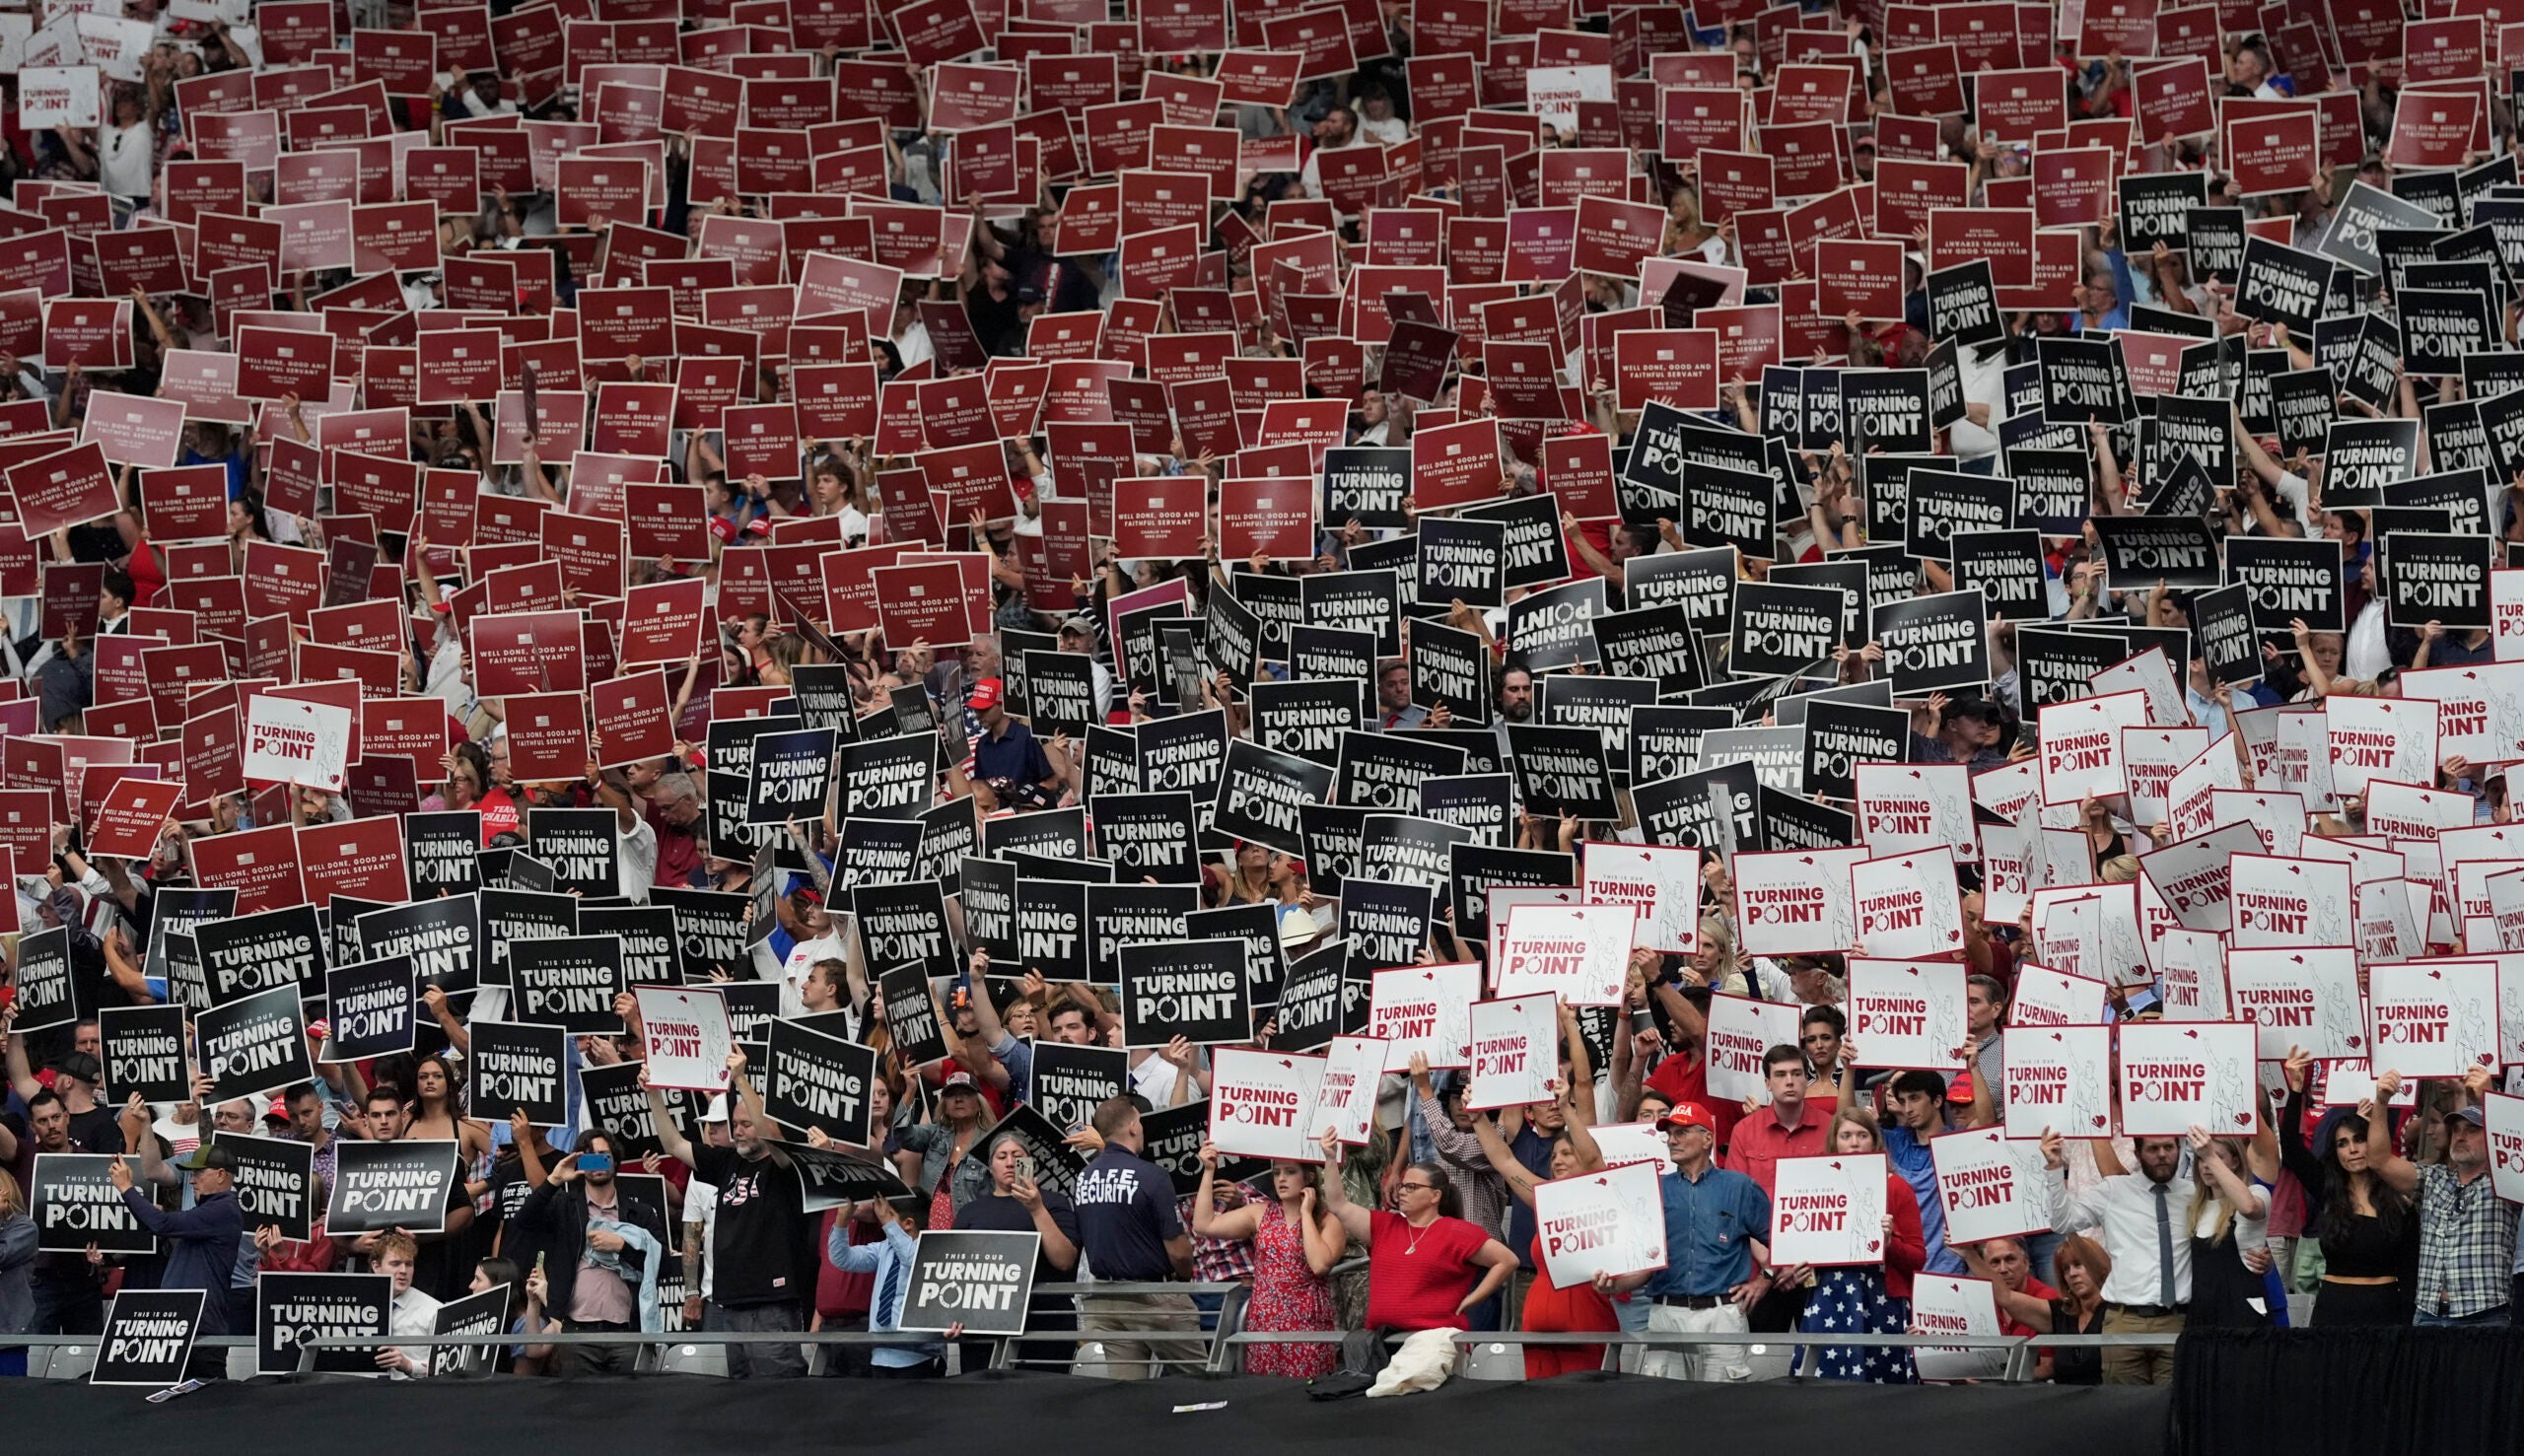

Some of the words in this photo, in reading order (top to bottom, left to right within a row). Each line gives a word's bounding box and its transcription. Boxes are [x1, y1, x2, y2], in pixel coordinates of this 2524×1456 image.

[1532, 90, 1581, 101] TURNING
[2248, 265, 2319, 296] TURNING
[2246, 282, 2320, 320] POINT
[2406, 315, 2478, 335] TURNING
[2048, 365, 2115, 386] TURNING
[2053, 382, 2117, 406] POINT
[2332, 447, 2406, 465] TURNING
[1330, 473, 1403, 490] TURNING
[2015, 473, 2083, 493] TURNING
[2329, 463, 2406, 490] POINT
[1331, 489, 1404, 511] POINT
[1690, 489, 1766, 517] TURNING
[2019, 493, 2084, 518] POINT
[1692, 509, 1766, 540] POINT
[1425, 543, 1495, 564] TURNING
[1426, 563, 1495, 589] POINT
[2234, 567, 2331, 586] TURNING
[2396, 562, 2481, 581] TURNING
[2248, 586, 2331, 611] POINT
[2399, 582, 2481, 607] POINT
[1743, 611, 1832, 633] TURNING
[1744, 630, 1834, 659] POINT
[1879, 620, 1975, 648] TURNING
[1885, 639, 1976, 673] POINT
[252, 725, 315, 743] TURNING
[2329, 731, 2395, 747] TURNING
[253, 738, 315, 760] POINT
[1145, 739, 1220, 766] TURNING
[2329, 746, 2395, 768] POINT
[759, 757, 826, 781] TURNING
[847, 761, 926, 788] TURNING
[1149, 757, 1223, 793] POINT
[758, 776, 824, 804] POINT
[848, 779, 925, 812] POINT
[1863, 800, 1930, 813] TURNING
[1102, 822, 1185, 841] TURNING
[1867, 815, 1931, 834] POINT
[412, 840, 475, 858] TURNING
[1106, 841, 1187, 869] POINT
[415, 859, 474, 883] POINT
[1743, 887, 1824, 903] TURNING
[2236, 893, 2307, 912] TURNING
[864, 912, 939, 934] TURNING
[1348, 911, 1421, 935] TURNING
[1747, 903, 1825, 925] POINT
[2240, 911, 2307, 935] POINT
[268, 931, 290, 939] OUR
[870, 932, 941, 960] POINT
[209, 936, 311, 968] TURNING
[17, 957, 64, 984] TURNING
[218, 954, 314, 994] POINT
[521, 967, 612, 987] TURNING
[17, 979, 65, 1009] POINT
[1132, 972, 1235, 995] TURNING
[336, 986, 406, 1015] TURNING
[526, 987, 615, 1013] POINT
[1137, 993, 1236, 1023] POINT
[1376, 1003, 1437, 1020] TURNING
[1856, 998, 1926, 1013] TURNING
[338, 1005, 407, 1042] POINT
[2375, 1005, 2448, 1020] TURNING
[206, 1017, 295, 1055] TURNING
[647, 1022, 700, 1037] TURNING
[1374, 1018, 1436, 1042] POINT
[1858, 1014, 1927, 1035] POINT
[2378, 1022, 2449, 1044] POINT
[107, 1036, 177, 1057] TURNING
[651, 1037, 701, 1058] POINT
[1476, 1036, 1526, 1054] TURNING
[111, 1057, 178, 1083] POINT
[209, 1037, 296, 1081] POINT
[477, 1052, 556, 1075] TURNING
[1476, 1053, 1526, 1076] POINT
[776, 1051, 861, 1094] TURNING
[2008, 1067, 2067, 1081] TURNING
[2126, 1064, 2205, 1078] TURNING
[480, 1073, 556, 1102] POINT
[777, 1075, 860, 1121] POINT
[1039, 1075, 1118, 1099] TURNING
[1219, 1086, 1297, 1105] TURNING
[2010, 1083, 2067, 1104] POINT
[2130, 1080, 2205, 1102] POINT
[1220, 1102, 1297, 1127] POINT
[347, 1170, 442, 1188] TURNING
[1077, 1169, 1139, 1187] S.A.F.E.
[343, 1188, 438, 1213] POINT
[1075, 1181, 1139, 1206] SECURITY
[1780, 1195, 1847, 1211] TURNING
[1780, 1211, 1847, 1232] POINT
[923, 1262, 1021, 1283] TURNING
[918, 1283, 1018, 1310] POINT
[270, 1305, 379, 1323] TURNING
[115, 1320, 188, 1337] TURNING
[107, 1338, 185, 1364] POINT
